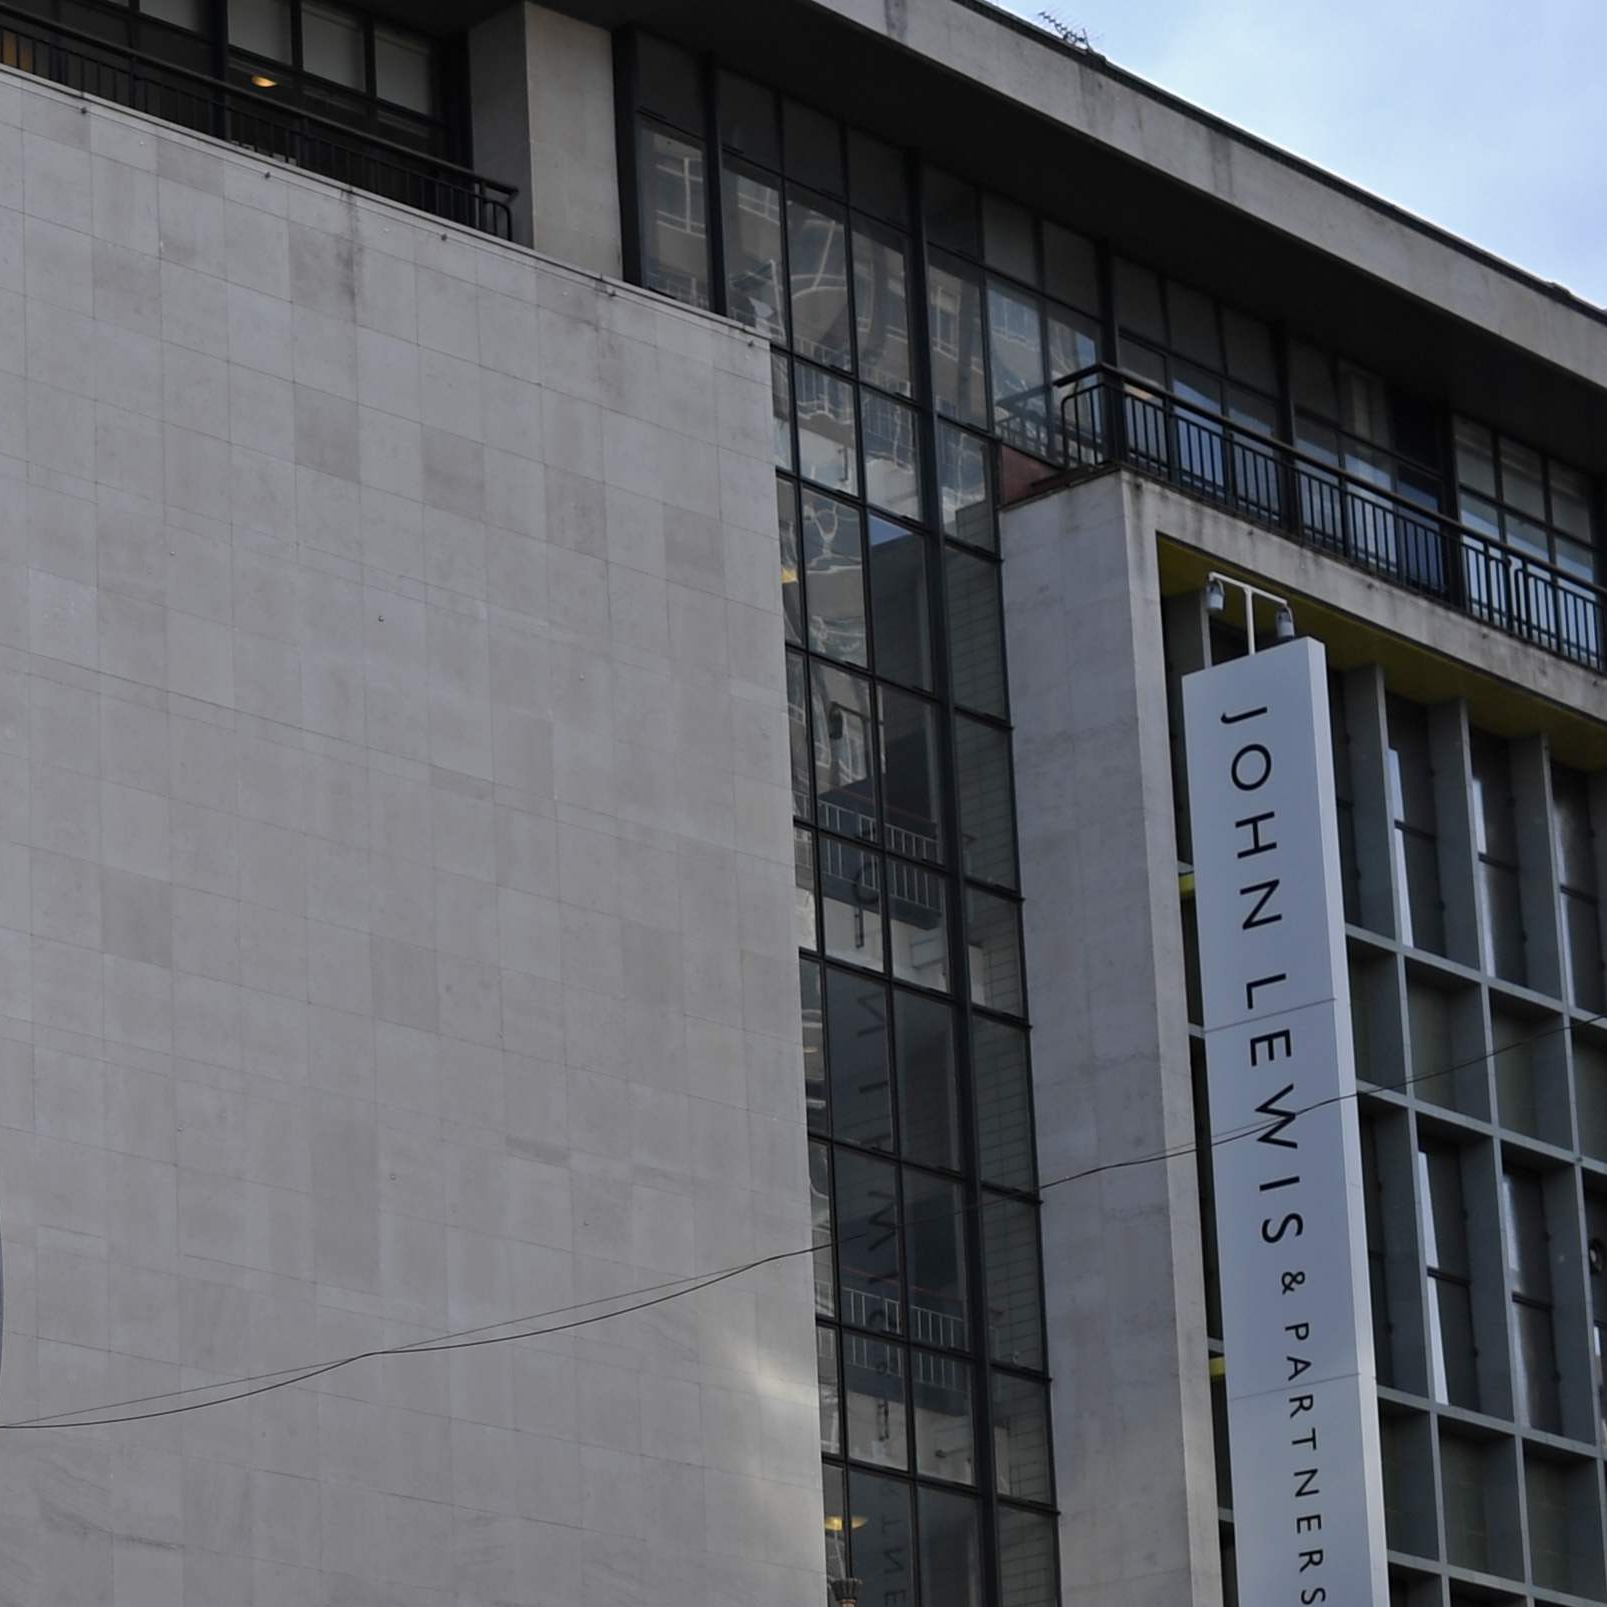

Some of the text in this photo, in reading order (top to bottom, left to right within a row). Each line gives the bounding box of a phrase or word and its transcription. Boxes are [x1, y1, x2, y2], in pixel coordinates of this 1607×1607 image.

[1220, 706, 1326, 1606] JOHN LEWIS & PARTNERS
